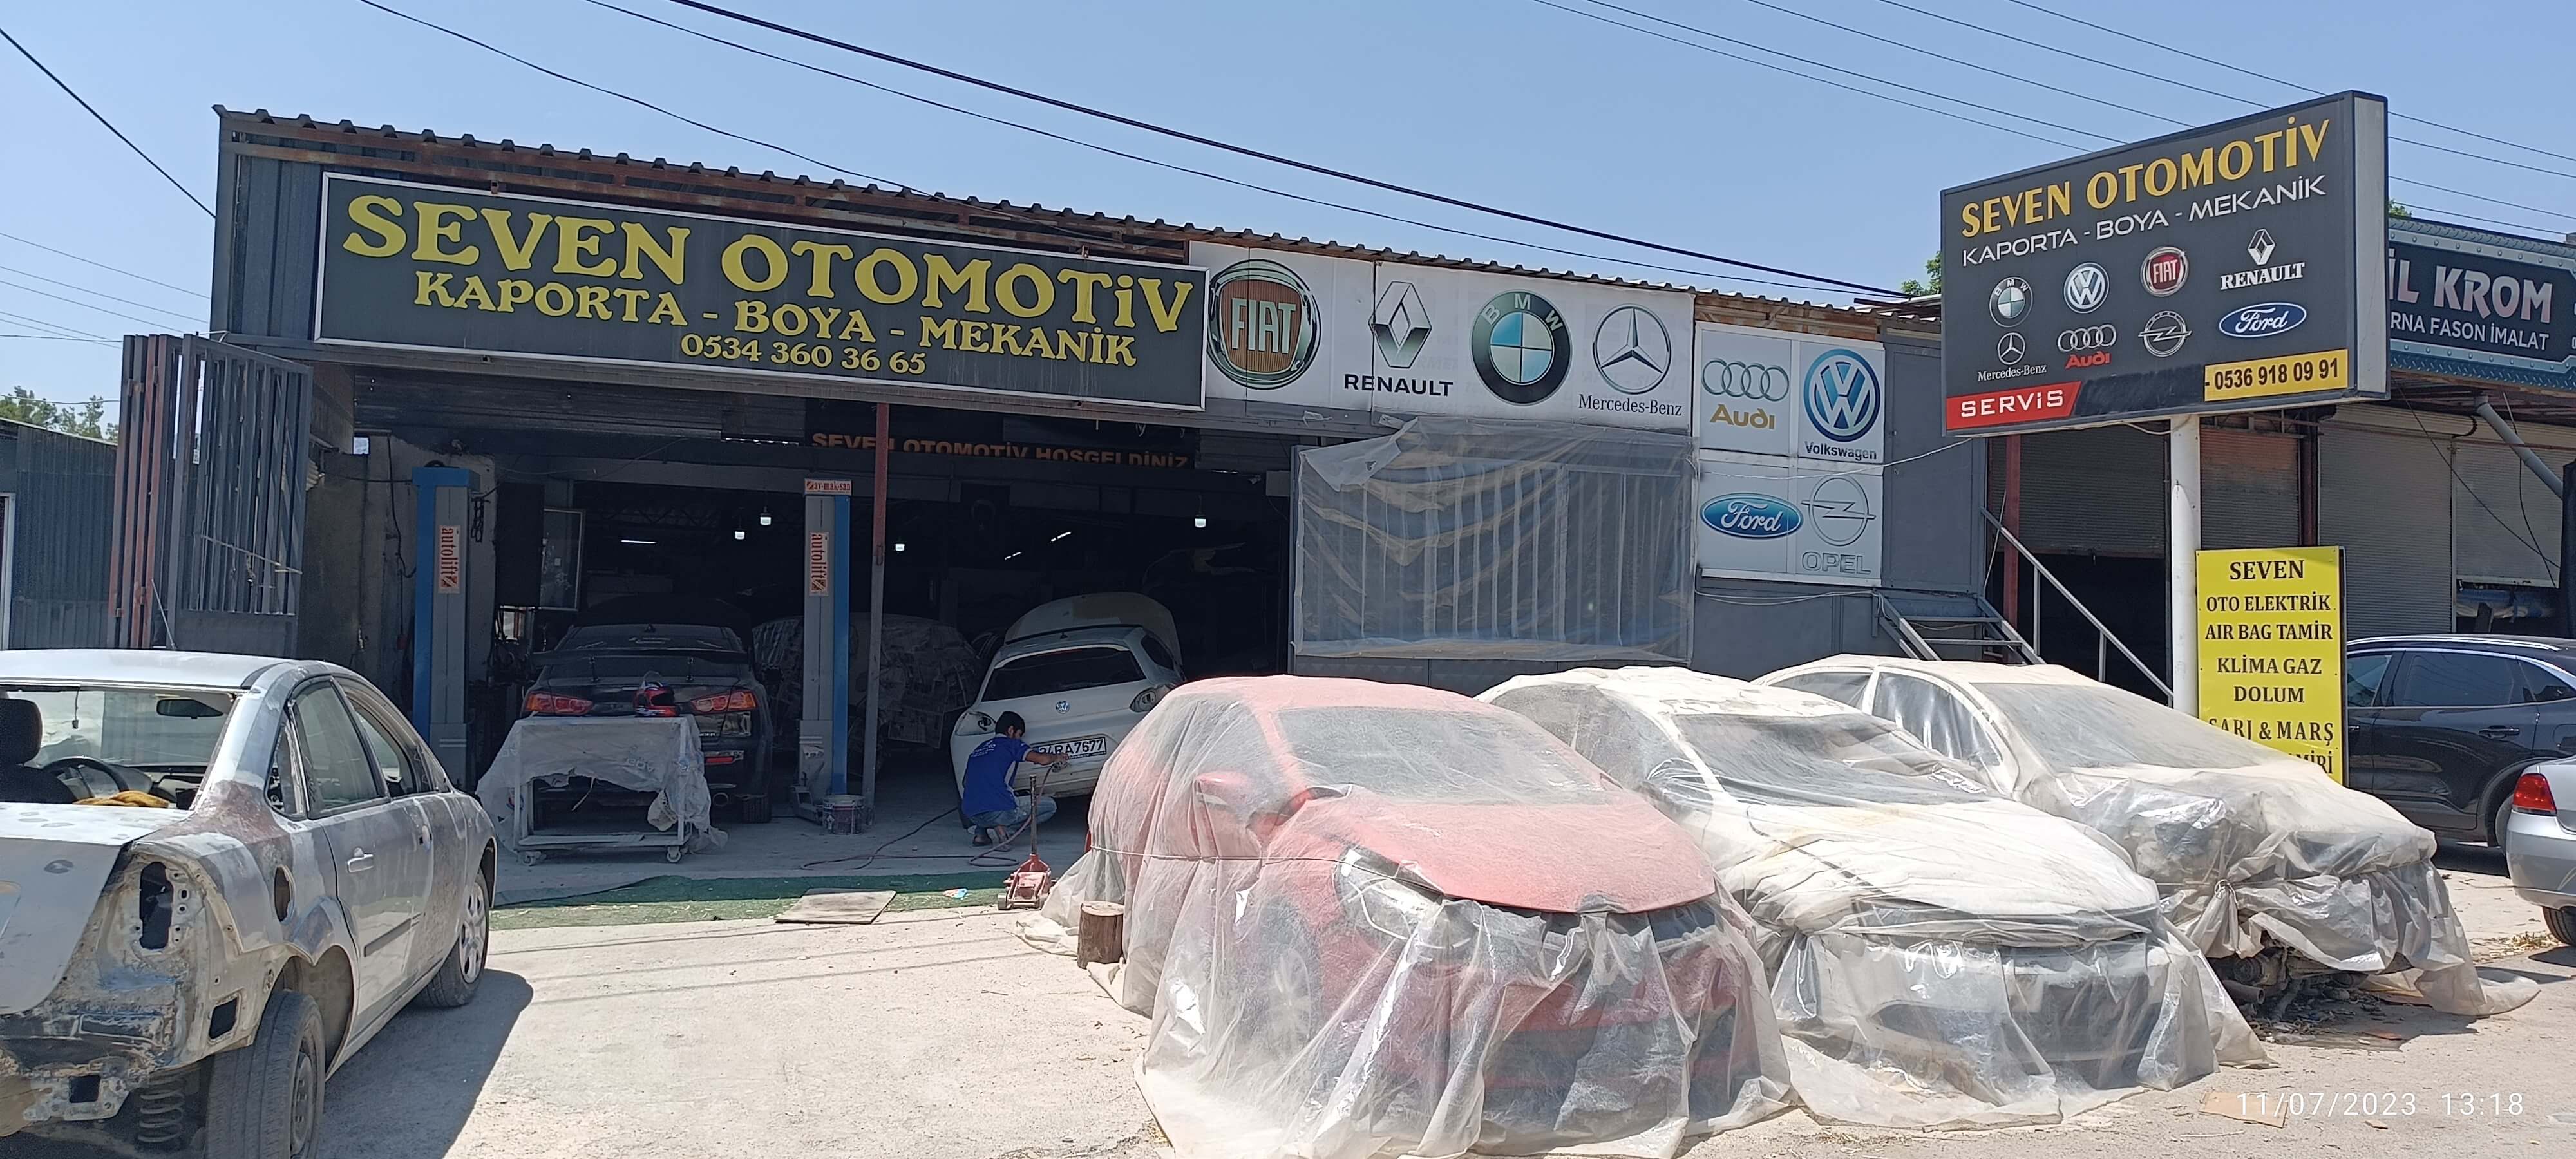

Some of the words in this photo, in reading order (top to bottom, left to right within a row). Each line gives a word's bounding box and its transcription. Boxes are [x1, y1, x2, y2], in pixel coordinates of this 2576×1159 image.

[1961, 181, 2071, 238] SEVEN
[2087, 116, 2330, 210] OTOMOTİV
[1963, 227, 2078, 267] KAPORTA
[2096, 209, 2168, 241] BOYA
[2189, 174, 2326, 221] MEKANİK
[343, 194, 690, 285] SEVEN
[2153, 259, 2177, 284] FIAT
[2220, 262, 2306, 290] RENAULT
[1994, 278, 2029, 296] BMW
[2434, 265, 2553, 324] KROM
[414, 270, 688, 326] KAPORTA
[734, 299, 876, 343] BOYA
[920, 316, 1137, 367] MEKANİK
[1482, 293, 1563, 332] BMW
[2235, 306, 2289, 334] Ford
[1231, 297, 1296, 355] FIAT
[2430, 317, 2485, 341] FASON
[2490, 323, 2549, 350] İMALAT
[681, 334, 762, 362] 0534
[771, 341, 833, 368] 360
[842, 347, 880, 371] 36
[889, 351, 926, 375] 65
[2065, 351, 2111, 369] Audi
[1344, 373, 1454, 397] RENAULT
[1978, 364, 2047, 382] Mercedes-Benz
[2215, 368, 2253, 390] 0536
[2258, 364, 2287, 385] 918
[2293, 361, 2313, 381] 09
[2319, 358, 2338, 379] 91
[1578, 393, 1682, 417] Mercedes-Benz
[1709, 404, 1776, 429] Audi
[1804, 440, 1877, 460] Volkswagen
[1721, 500, 1783, 532] Ford
[441, 528, 458, 574] autolift
[811, 534, 826, 578] autolift
[1802, 551, 1871, 575] OPEL
[2230, 560, 2304, 580] SEVEN
[2206, 596, 2240, 612] OTO
[2244, 591, 2331, 611] ELEKTRİK
[2205, 624, 2233, 639] AIR
[2237, 624, 2272, 639] BAG
[2277, 620, 2333, 640] TAMİR
[2217, 655, 2278, 674] KLİMA
[2283, 658, 2322, 674] GAZ
[2234, 686, 2305, 703] DOLUM
[2259, 722, 2271, 740] &
[2277, 721, 2333, 746] MARŞ
